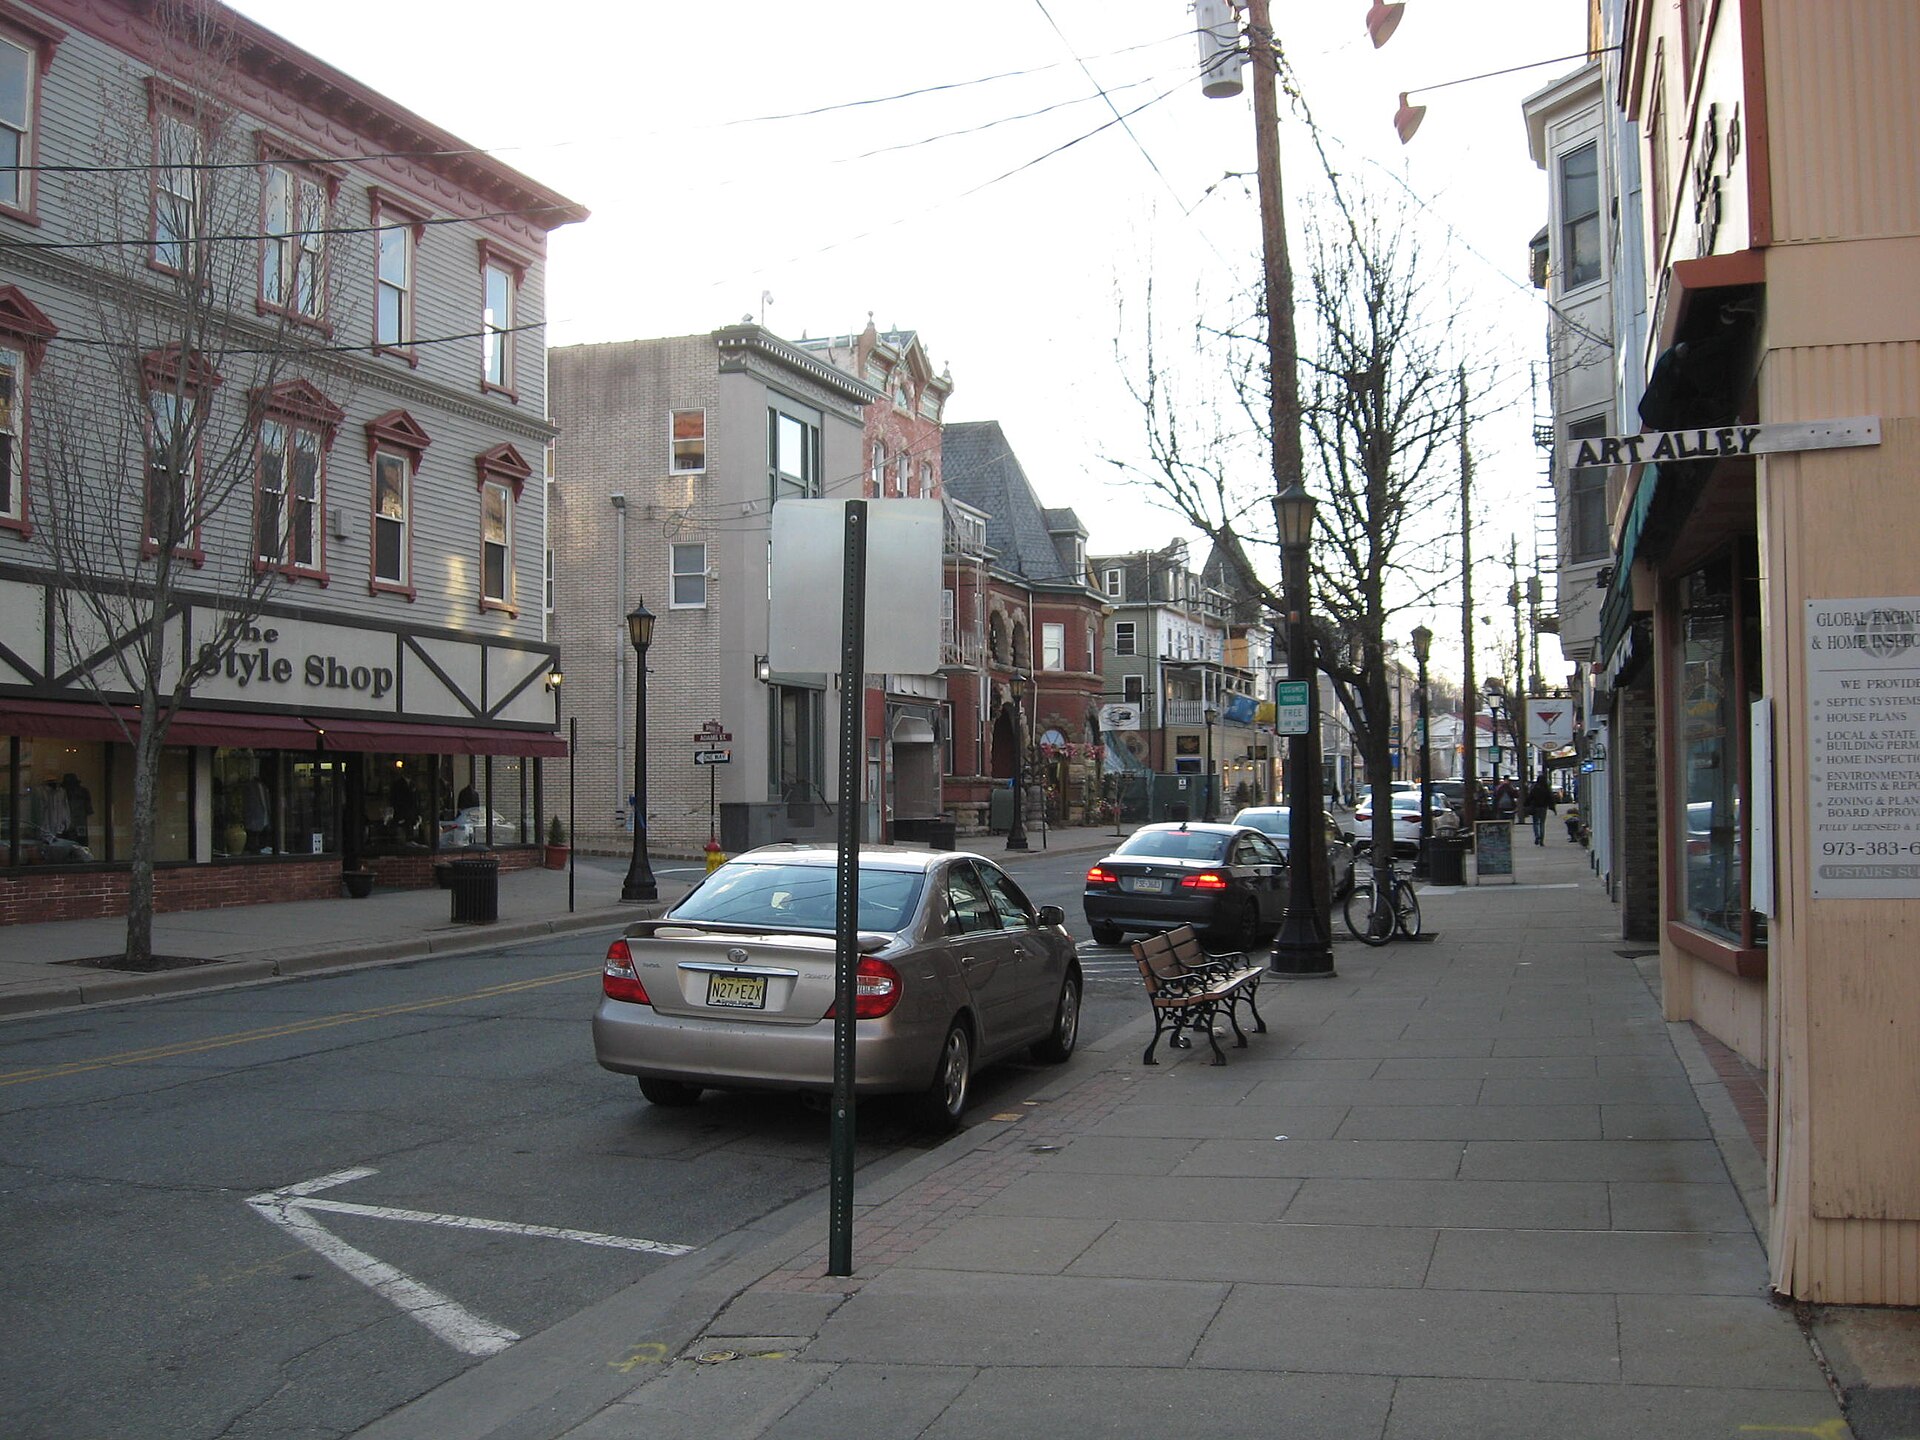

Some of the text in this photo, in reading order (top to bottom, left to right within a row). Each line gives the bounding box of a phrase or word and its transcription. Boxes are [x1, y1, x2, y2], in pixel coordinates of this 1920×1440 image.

[1576, 428, 1760, 466] ART ALLEY
[1816, 611, 1867, 627] GLOBAL
[226, 617, 279, 643] The
[1811, 635, 1821, 649] &
[1827, 634, 1866, 649] HOME
[199, 642, 393, 698] Style Shop
[1840, 679, 1861, 690] WE
[1826, 696, 1920, 707] SEPTIC SYSTEMS
[1283, 708, 1303, 717] FREE
[1826, 711, 1907, 722] HOUSE PLANS
[1827, 730, 1917, 740] LOCAL & STATE
[1826, 741, 1884, 750] BUILDING
[1826, 755, 1862, 764] HOME
[1827, 781, 1877, 791] PERMITS
[1880, 781, 1888, 790] &
[1828, 796, 1873, 806] ZONING
[1876, 796, 1884, 806] &
[1828, 808, 1870, 817] BOARD
[1818, 823, 1848, 831] FULLY
[1851, 823, 1900, 831] LICENSED
[1822, 841, 1920, 856] 973-383-6
